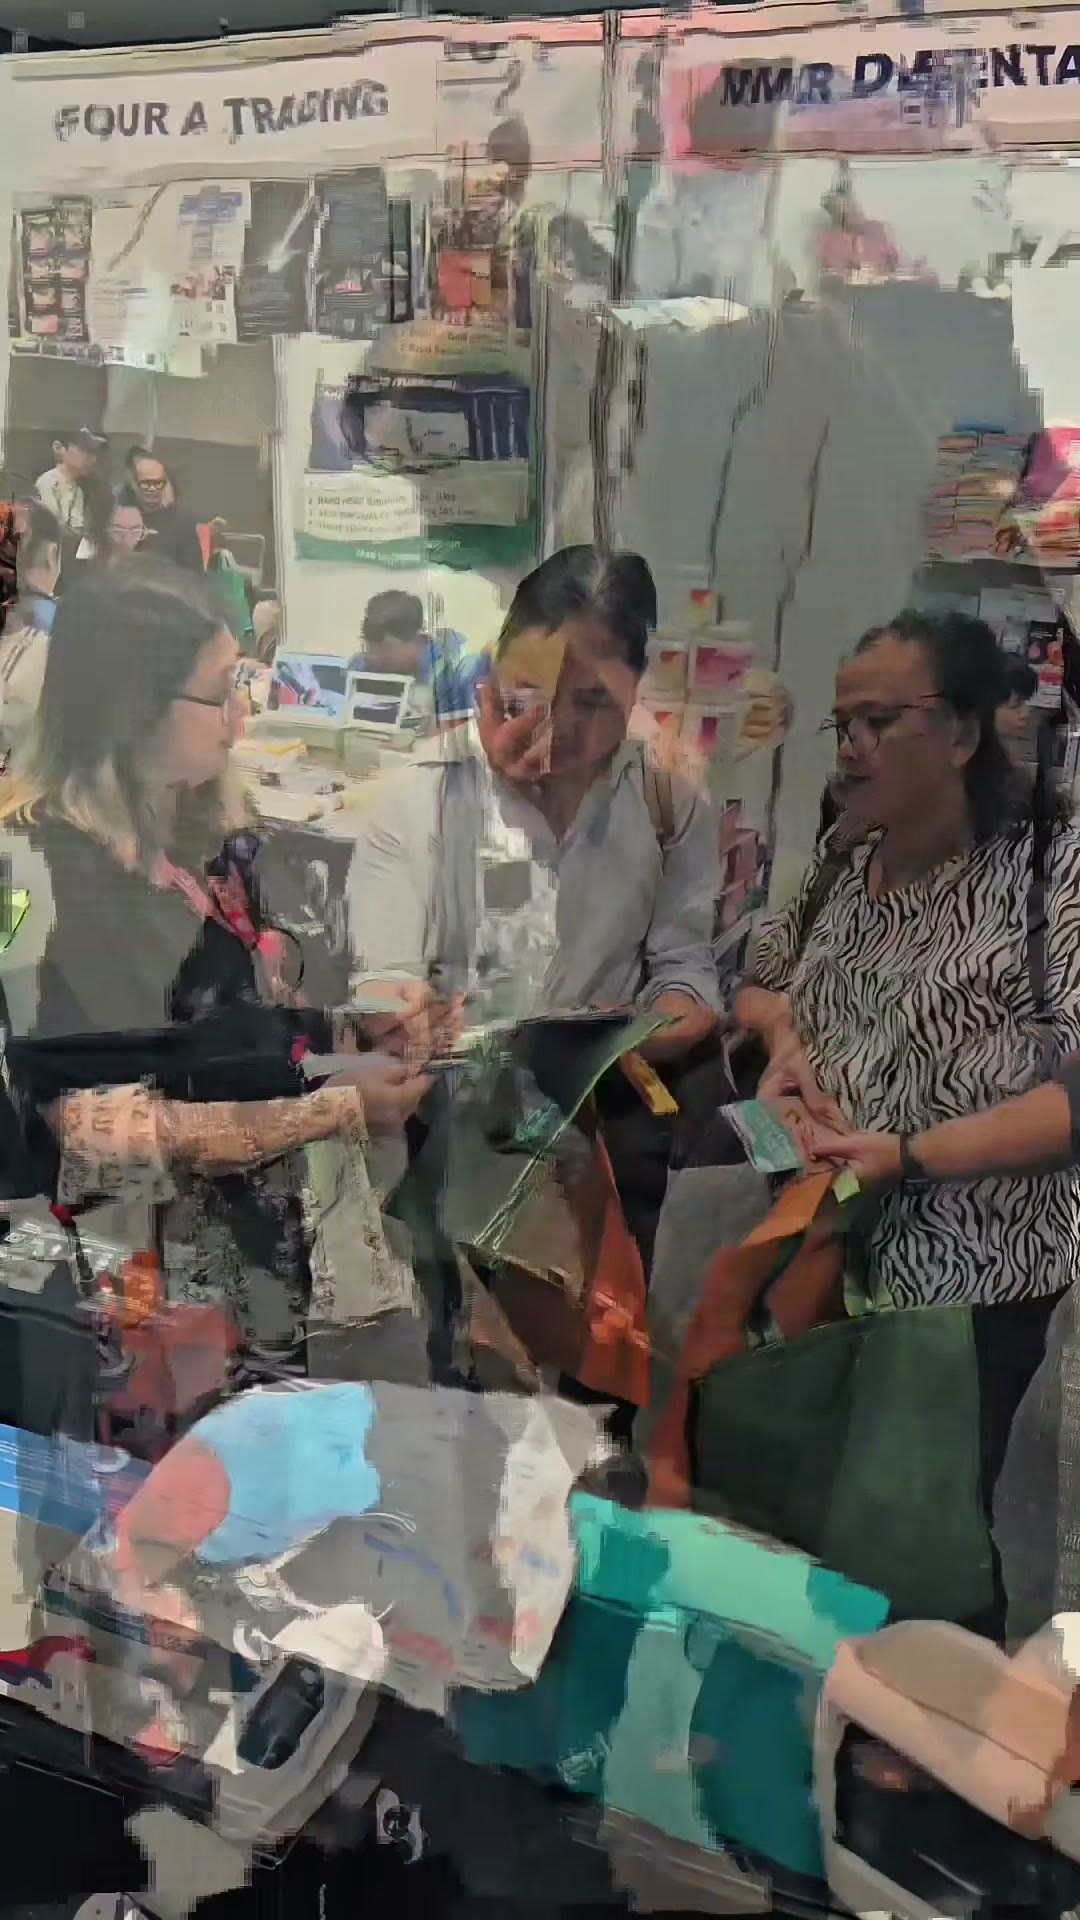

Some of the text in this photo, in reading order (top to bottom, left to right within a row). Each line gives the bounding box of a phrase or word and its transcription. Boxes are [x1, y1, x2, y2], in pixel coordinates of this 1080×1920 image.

[56, 80, 389, 138] FOUR A TRADING
